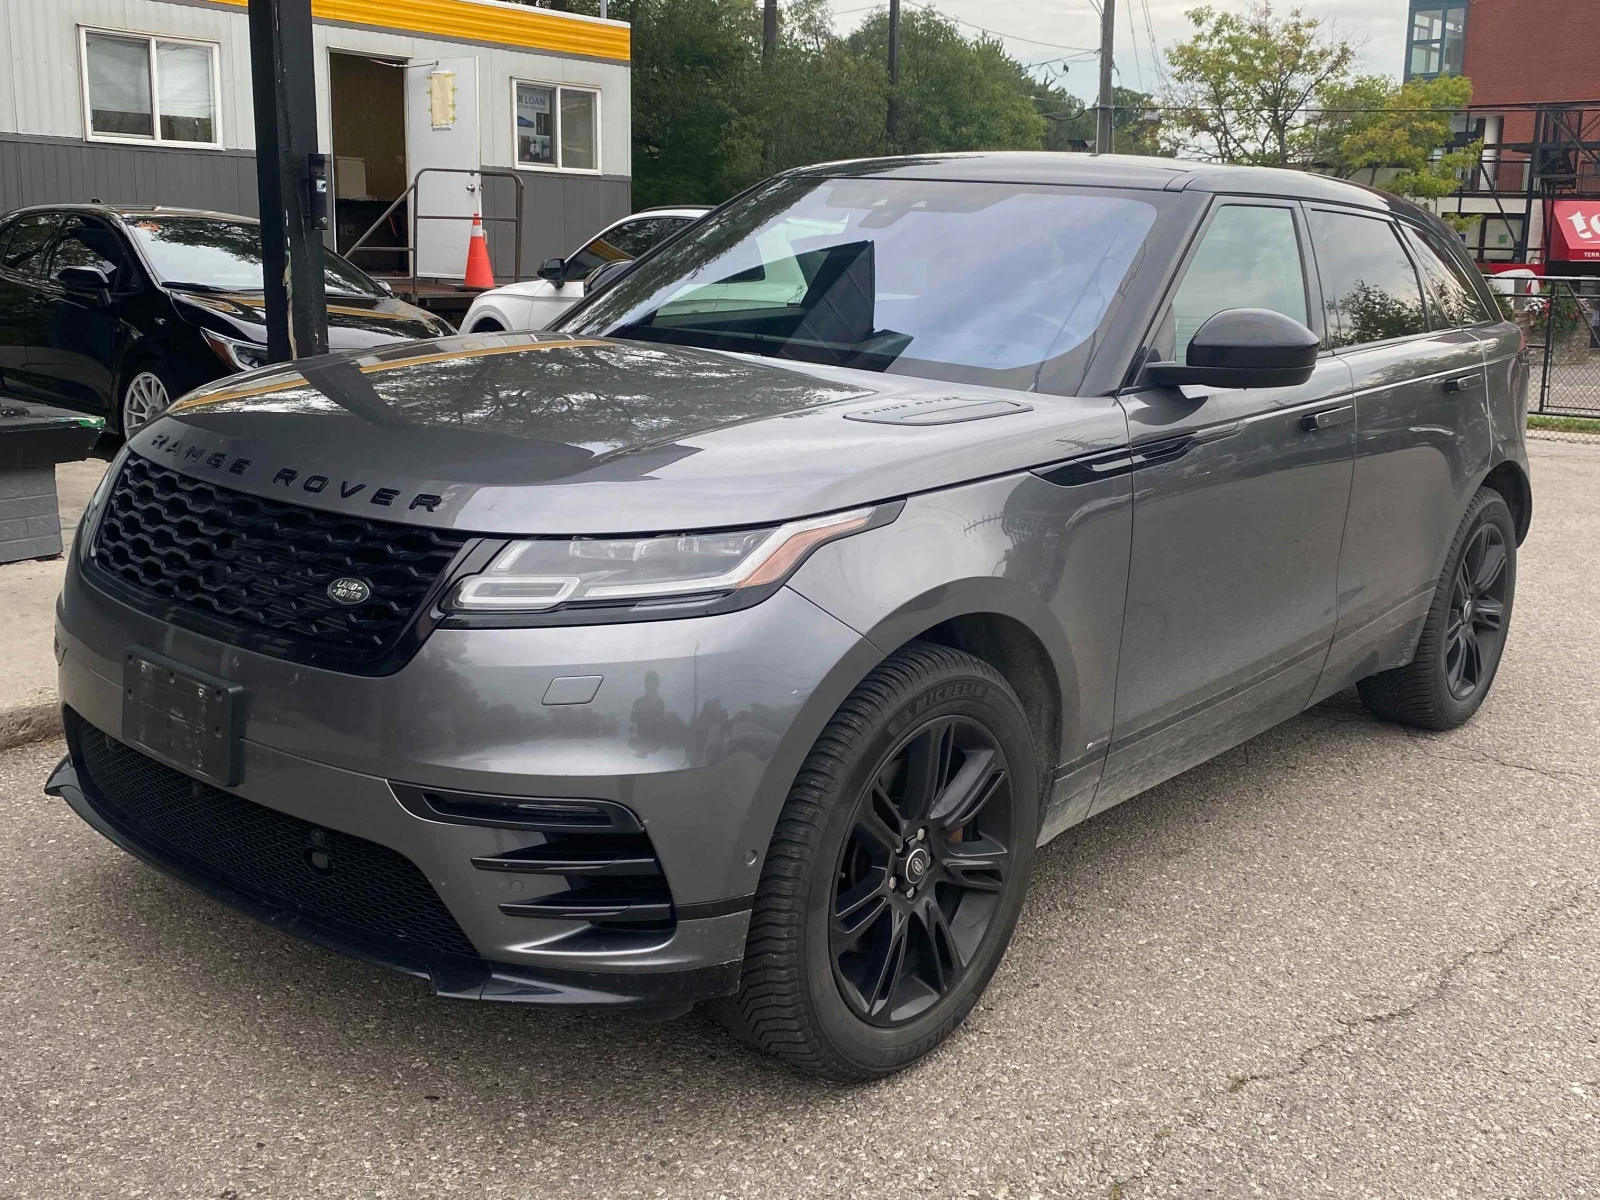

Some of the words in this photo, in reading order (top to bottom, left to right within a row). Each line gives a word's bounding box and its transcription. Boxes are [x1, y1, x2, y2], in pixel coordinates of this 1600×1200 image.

[525, 95, 546, 106] LOAN
[862, 404, 908, 416] RANGE
[915, 396, 960, 406] ROVER
[150, 432, 254, 476] RANGE
[273, 467, 444, 513] ROVER
[914, 682, 985, 714] MICHELIN
